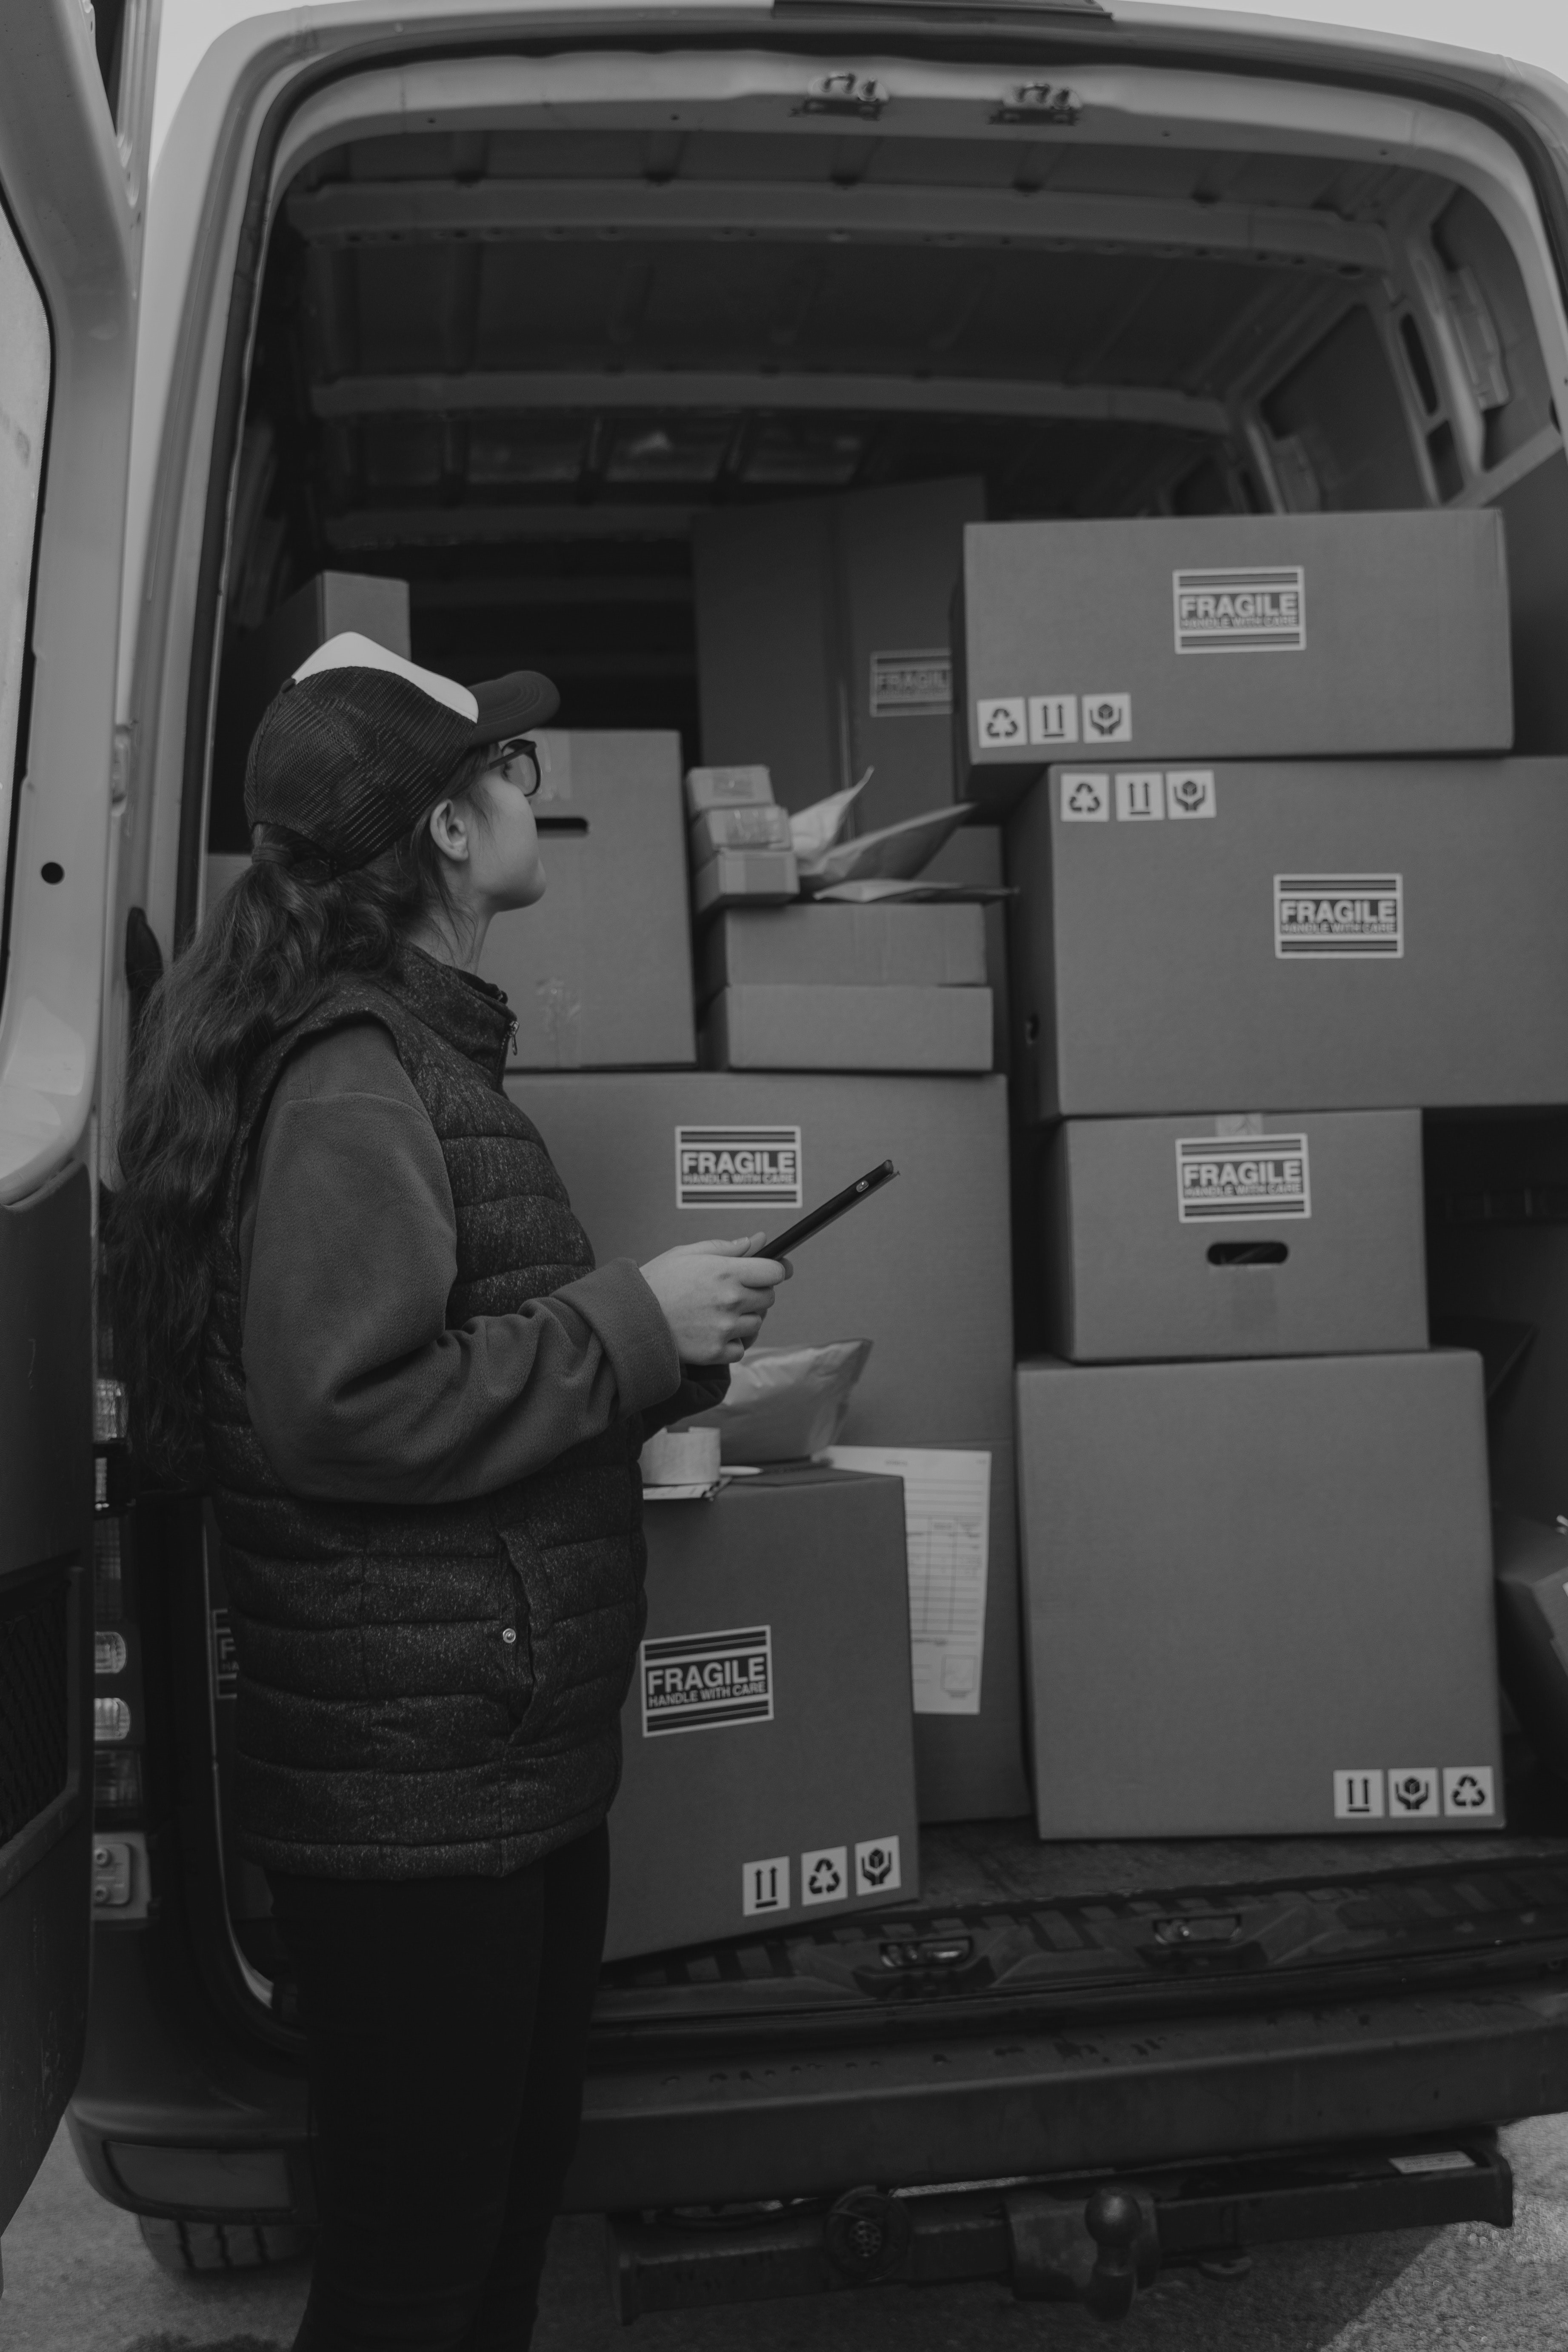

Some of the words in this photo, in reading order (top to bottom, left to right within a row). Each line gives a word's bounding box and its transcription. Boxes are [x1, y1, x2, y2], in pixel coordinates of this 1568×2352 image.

[1181, 593, 1297, 619] FRAGILE
[877, 672, 952, 690] FRAGIL
[1281, 900, 1396, 923] FRAGILE
[682, 1151, 795, 1174] FRAGILE
[1183, 1160, 1302, 1186] FRAGILE
[647, 1656, 765, 1695] FRAGILE
[648, 1690, 698, 1707] HANDLE
[700, 1686, 731, 1701] WITH
[732, 1681, 766, 1696] CARE
